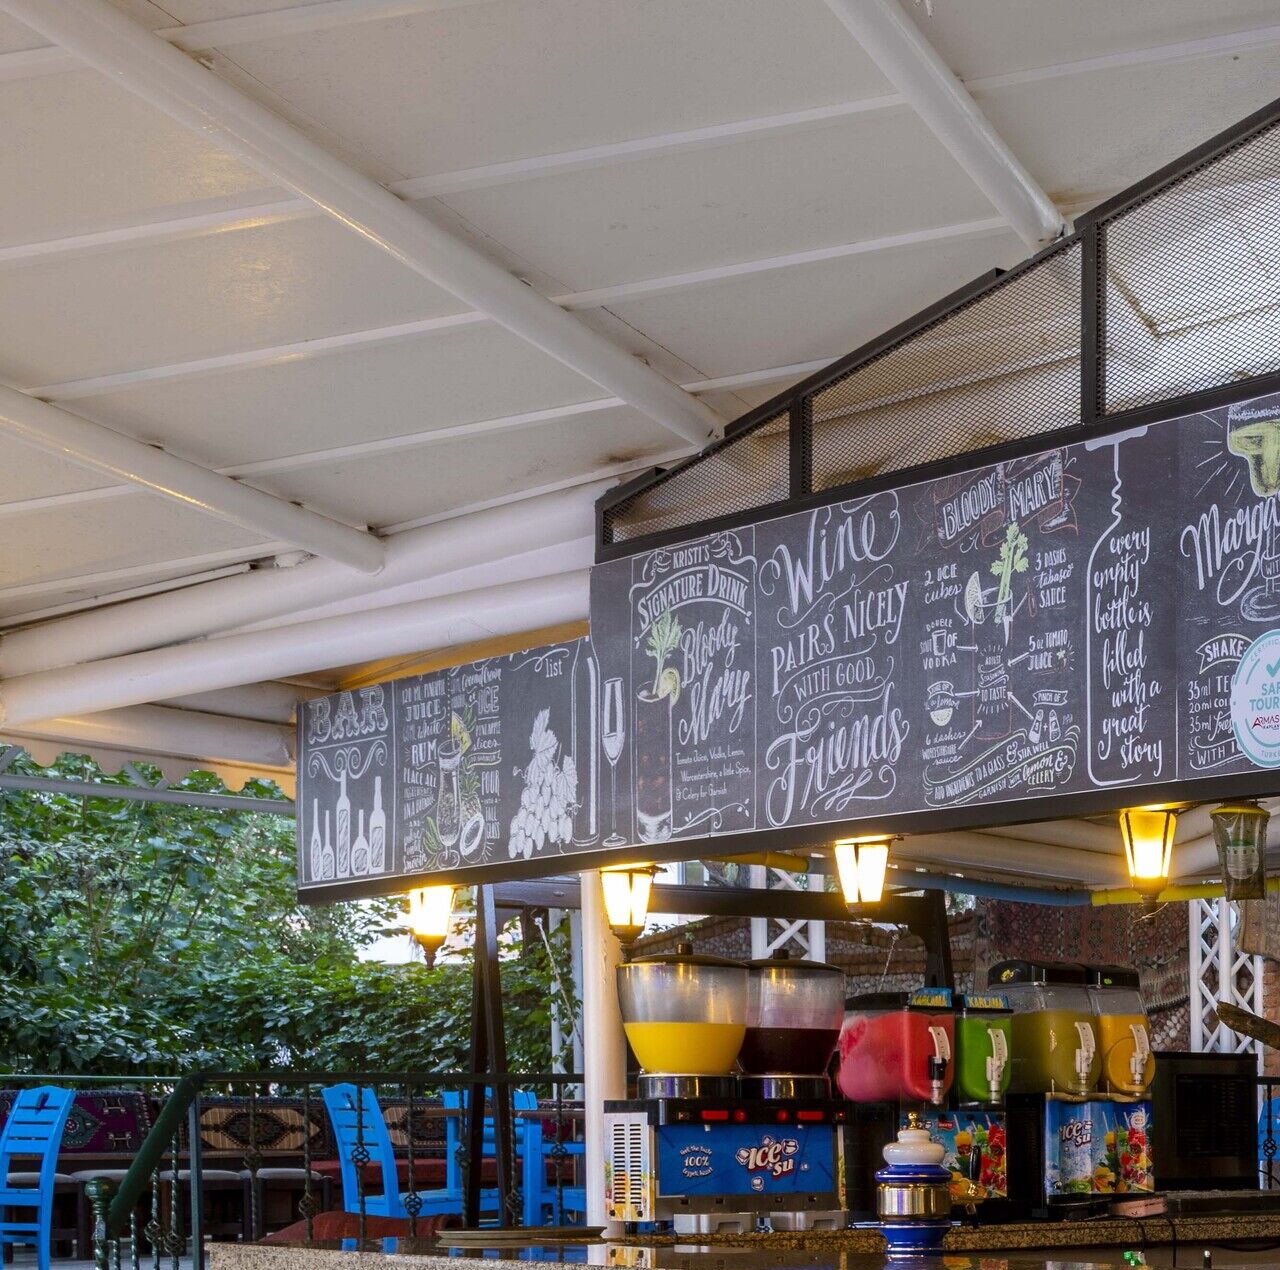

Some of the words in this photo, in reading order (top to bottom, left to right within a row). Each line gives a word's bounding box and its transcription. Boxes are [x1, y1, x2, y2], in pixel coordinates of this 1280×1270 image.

[943, 472, 999, 540] BLOODY
[1009, 463, 1057, 521] MARY
[673, 545, 710, 569] KRISTI'S
[759, 490, 900, 616] Wine
[1110, 527, 1151, 564] every
[937, 563, 958, 580] ICE
[1093, 559, 1141, 598] empty
[638, 573, 703, 631] SIGNATURE
[707, 564, 749, 610] DRINK
[1039, 586, 1067, 608] SAUCE
[1095, 585, 1136, 635] bottle
[682, 607, 741, 688] Bloody
[770, 613, 835, 699] PAIRS
[843, 580, 911, 645] NICELY
[545, 658, 563, 678] list
[794, 671, 831, 702] WITH
[836, 655, 876, 688] GOOD
[923, 652, 957, 670] VODKA
[1103, 630, 1148, 691] filled
[477, 685, 500, 716] ICE
[679, 662, 752, 745] Mary
[1112, 671, 1147, 709] with
[1149, 680, 1162, 697] a
[308, 685, 389, 745] BAR
[405, 699, 440, 722] JUICE
[1252, 714, 1280, 730] ARMAS
[411, 738, 437, 767] RUM
[765, 682, 910, 828] Friends
[1120, 736, 1163, 777] story
[684, 1156, 710, 1167] 100%
